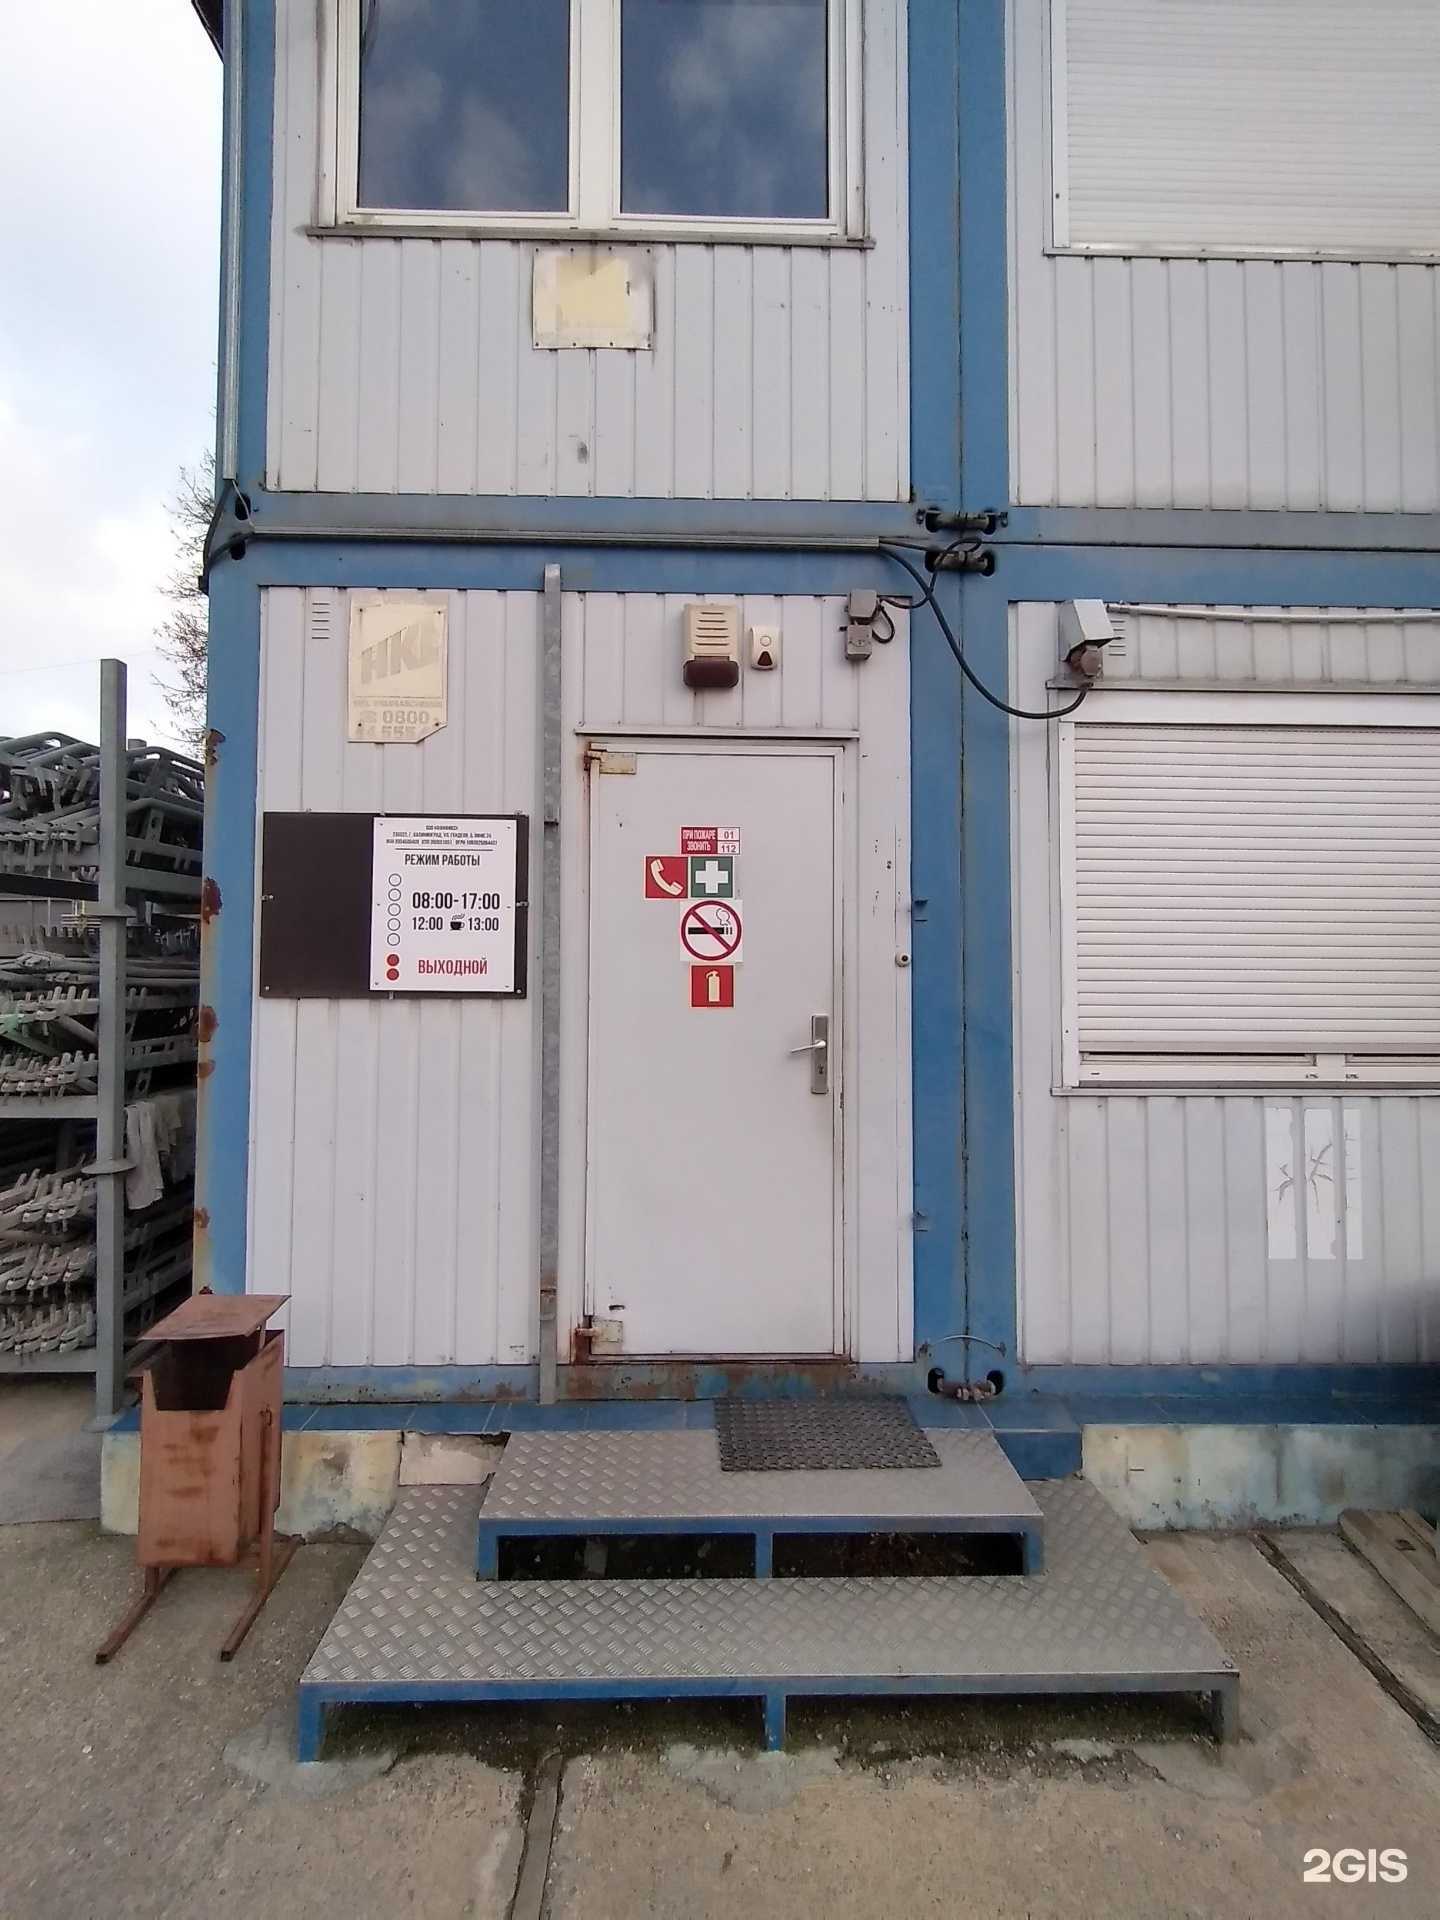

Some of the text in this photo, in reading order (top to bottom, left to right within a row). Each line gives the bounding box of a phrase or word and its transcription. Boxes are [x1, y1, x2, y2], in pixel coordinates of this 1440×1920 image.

[382, 710, 430, 724] 0800
[682, 829, 717, 840] ПРИ ПОЖАРЕ
[723, 831, 735, 840] 01
[686, 840, 711, 851] ЗВОНИТЬ
[721, 844, 737, 853] 112
[404, 853, 480, 866] РЕЖИМ РАБОТЫ
[412, 916, 500, 932] 12:00 13:00
[418, 956, 488, 976] ВЫХОДНОЙ
